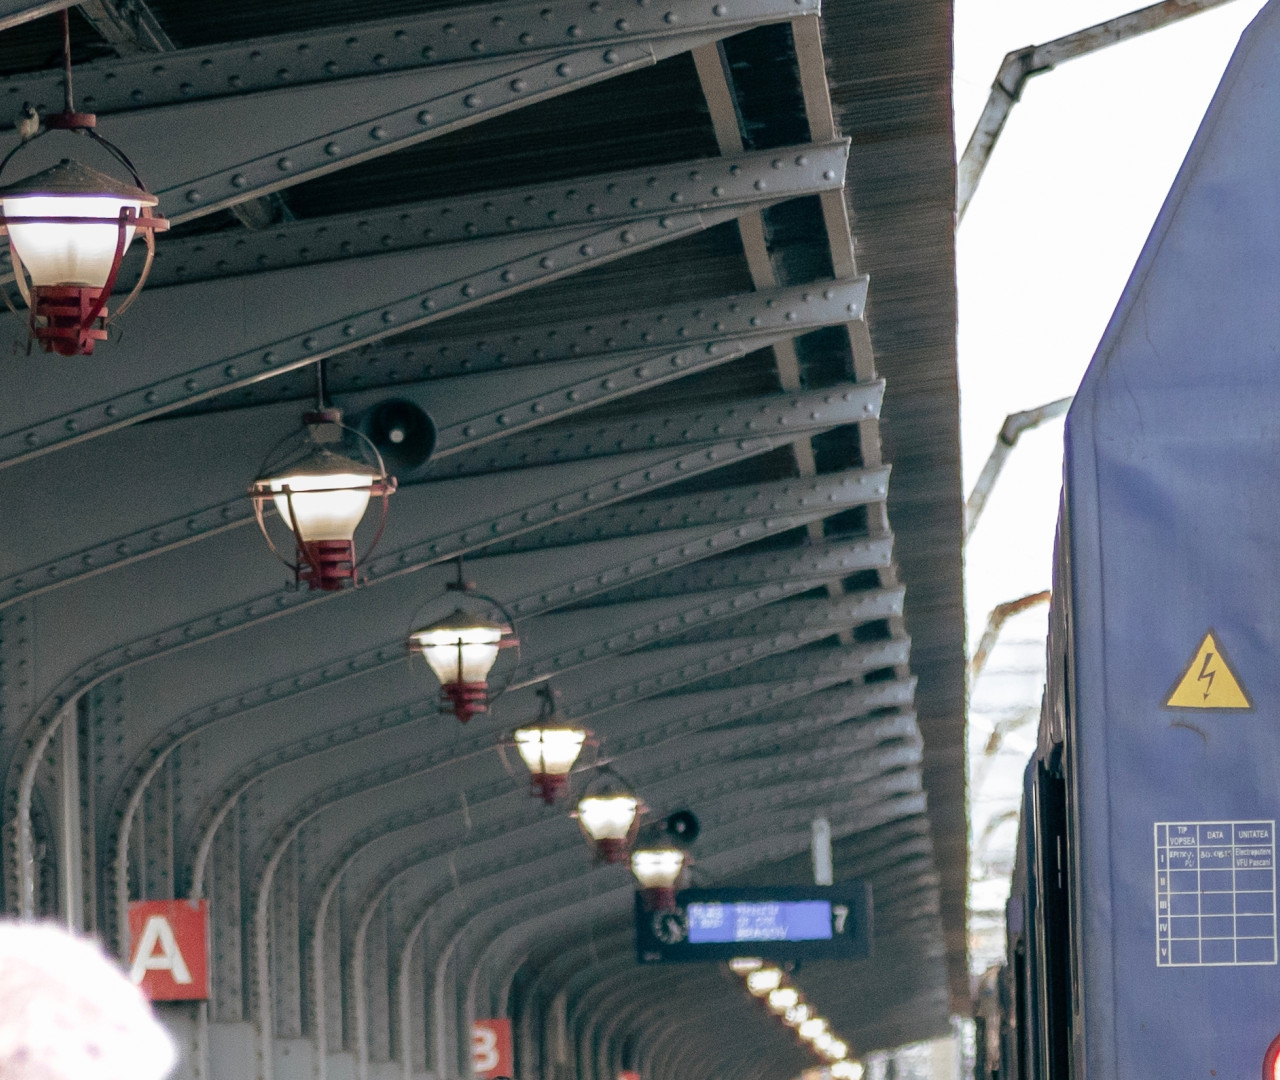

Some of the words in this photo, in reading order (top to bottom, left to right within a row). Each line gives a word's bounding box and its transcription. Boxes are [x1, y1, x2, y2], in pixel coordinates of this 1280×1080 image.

[1177, 826, 1188, 834] TIP
[1207, 831, 1224, 839] DATA
[1238, 830, 1269, 839] UNITATEA
[1170, 837, 1196, 846] VOPSEA
[1236, 859, 1248, 867] VFU
[833, 904, 849, 934] 7
[1160, 924, 1168, 932] IV
[130, 914, 193, 985] A
[1161, 948, 1168, 957] V
